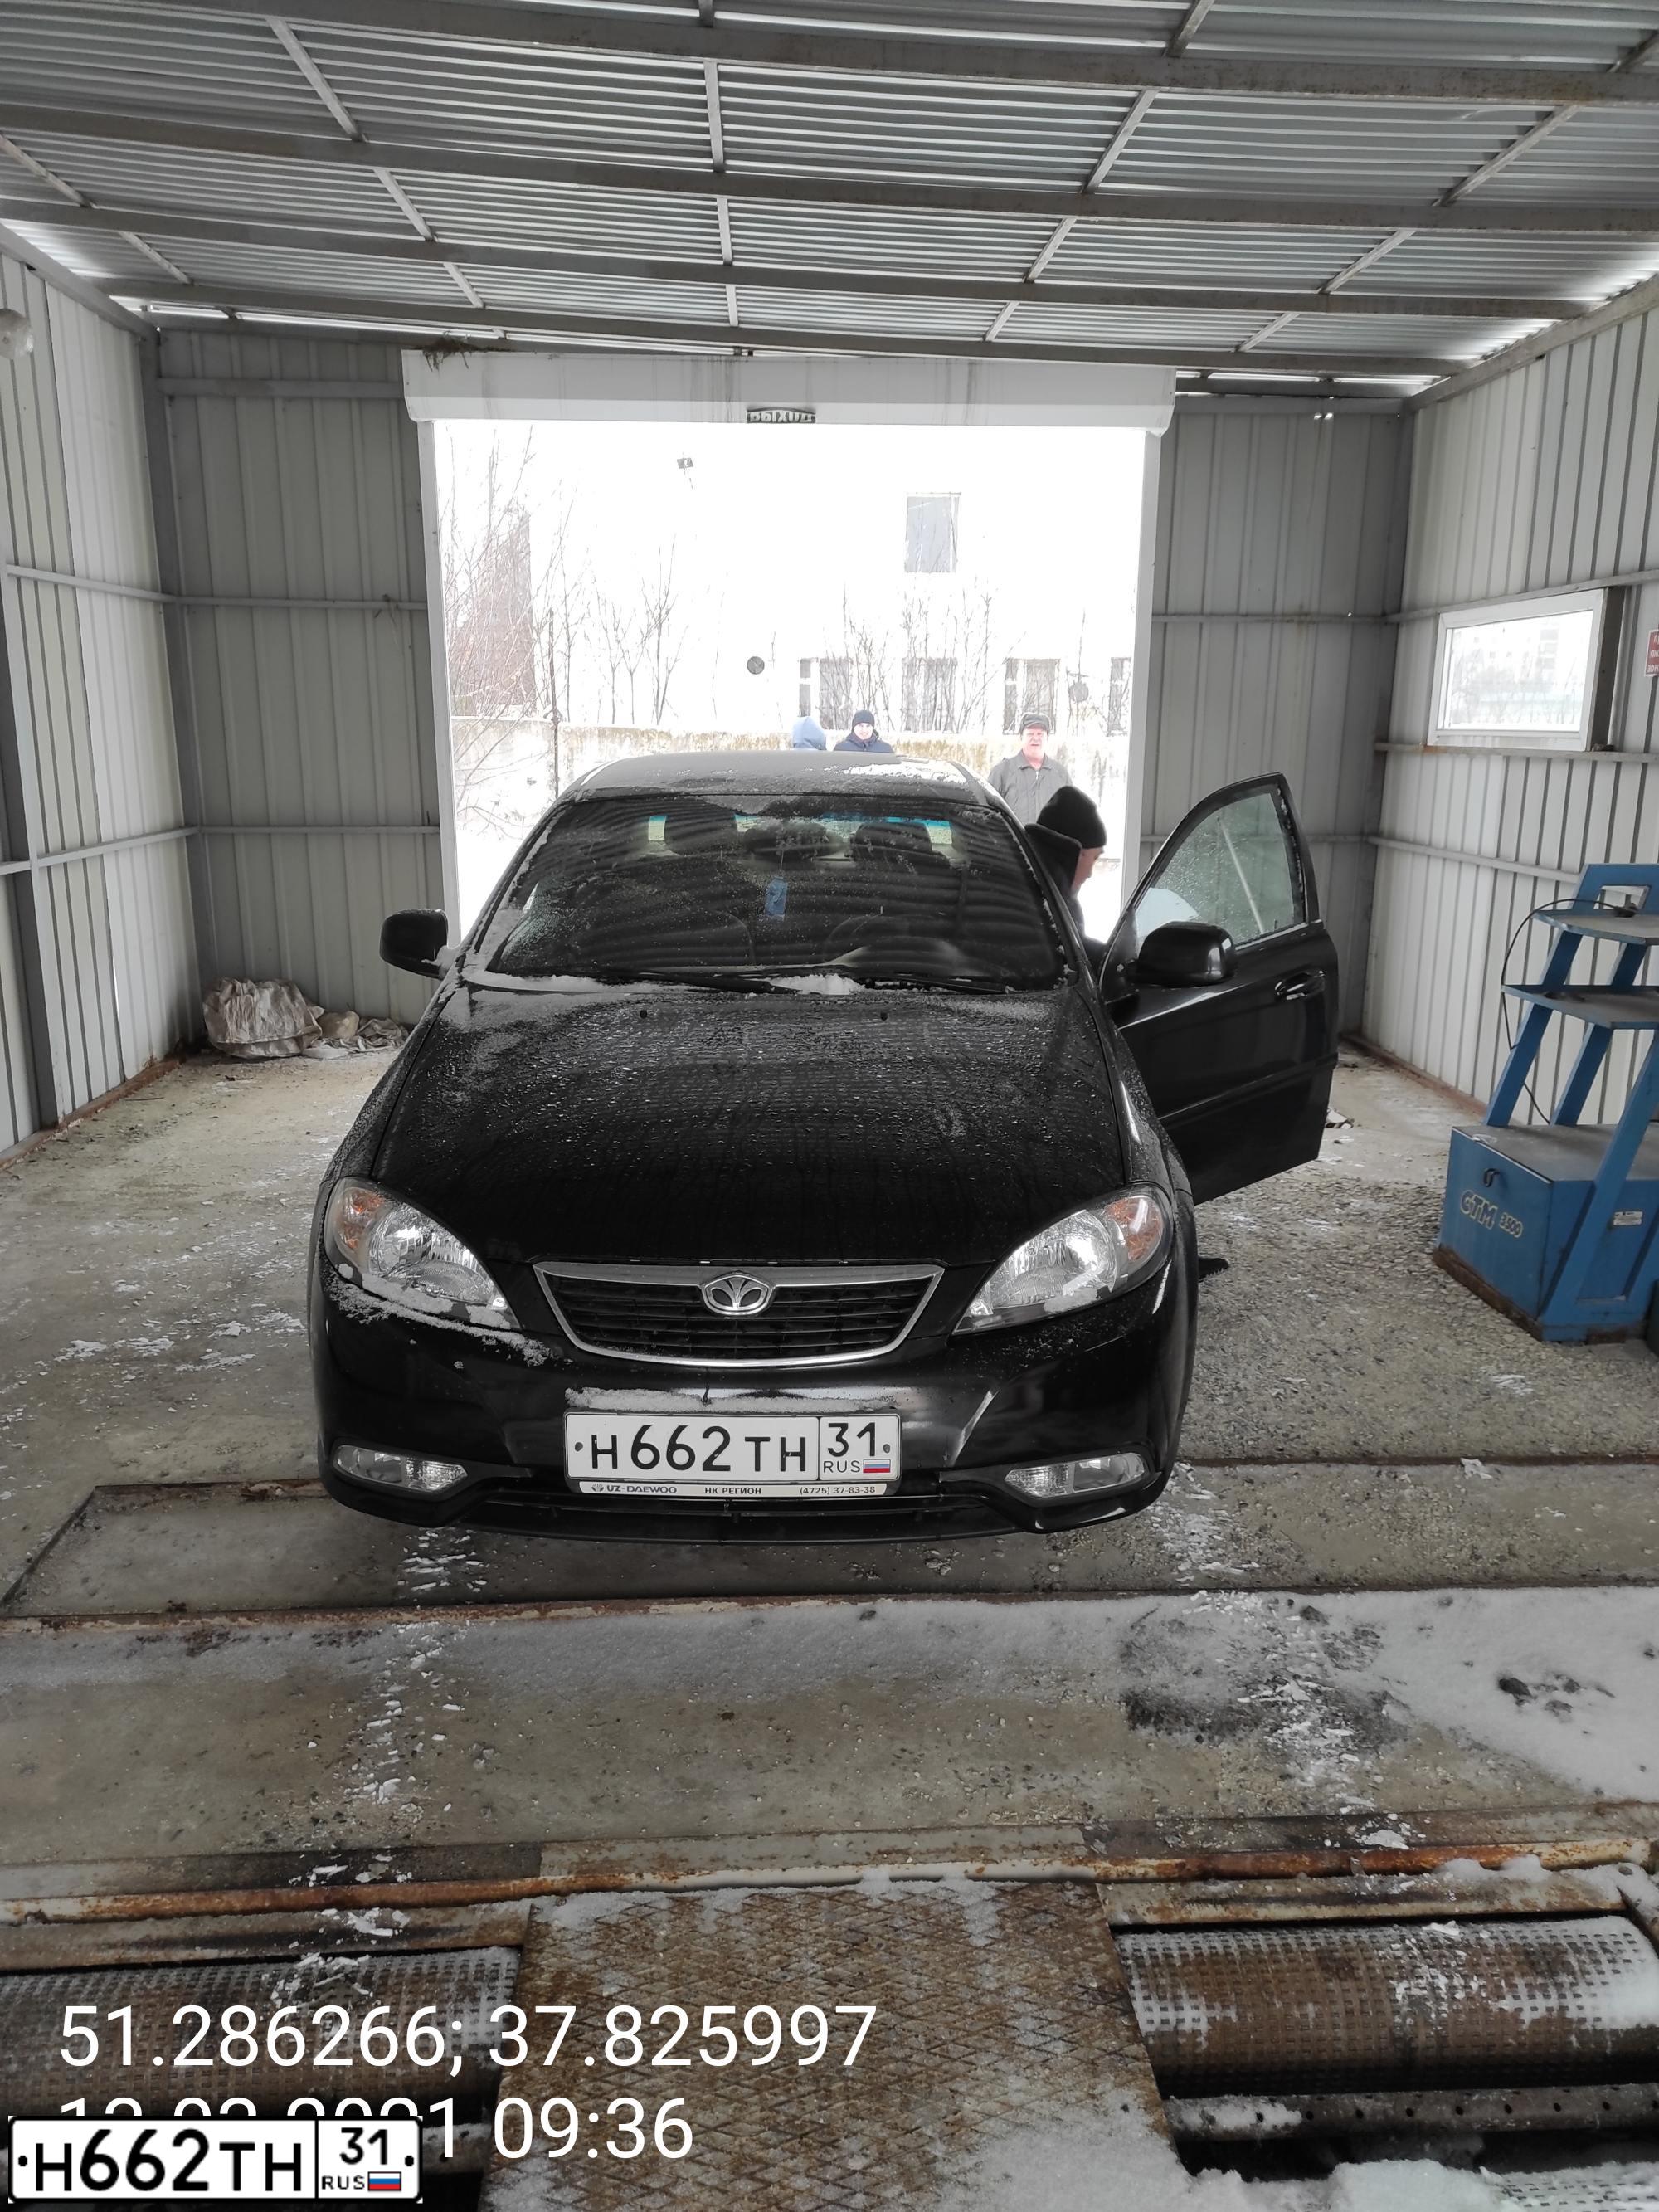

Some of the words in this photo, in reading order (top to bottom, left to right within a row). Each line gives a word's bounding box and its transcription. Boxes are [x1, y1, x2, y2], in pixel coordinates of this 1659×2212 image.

[591, 1424, 806, 1473] Н662ТН
[827, 1422, 876, 1457] 31
[823, 1460, 860, 1474] RUS
[704, 1486, 720, 1494] НК
[722, 1486, 762, 1495] РЕГИОН
[800, 1486, 830, 1495] (4725)
[833, 1485, 876, 1494] 37-83-38
